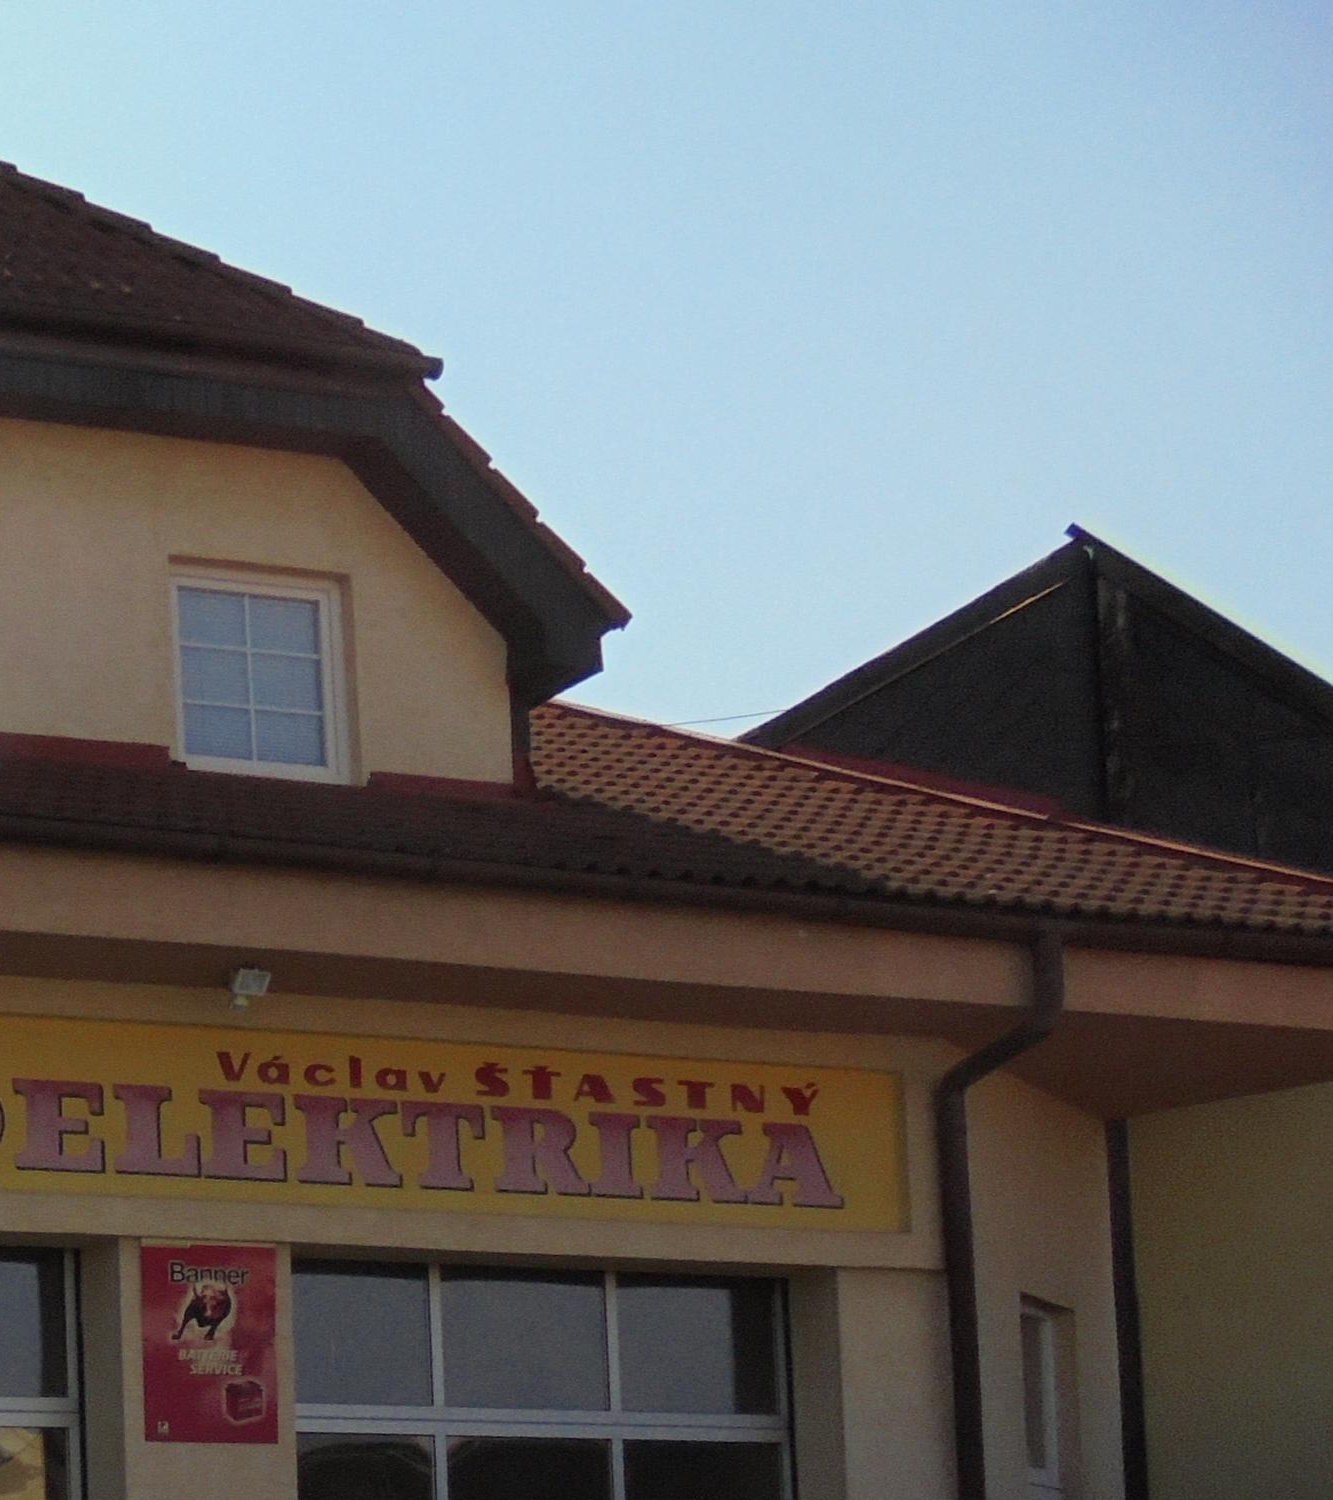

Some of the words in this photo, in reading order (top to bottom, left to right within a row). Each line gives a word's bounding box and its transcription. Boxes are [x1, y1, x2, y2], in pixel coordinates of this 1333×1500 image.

[217, 1051, 446, 1094] Václav
[475, 1061, 821, 1118] ŠŤASTNÝ
[170, 1262, 249, 1285] Banner
[190, 1363, 243, 1375] SERVICE
